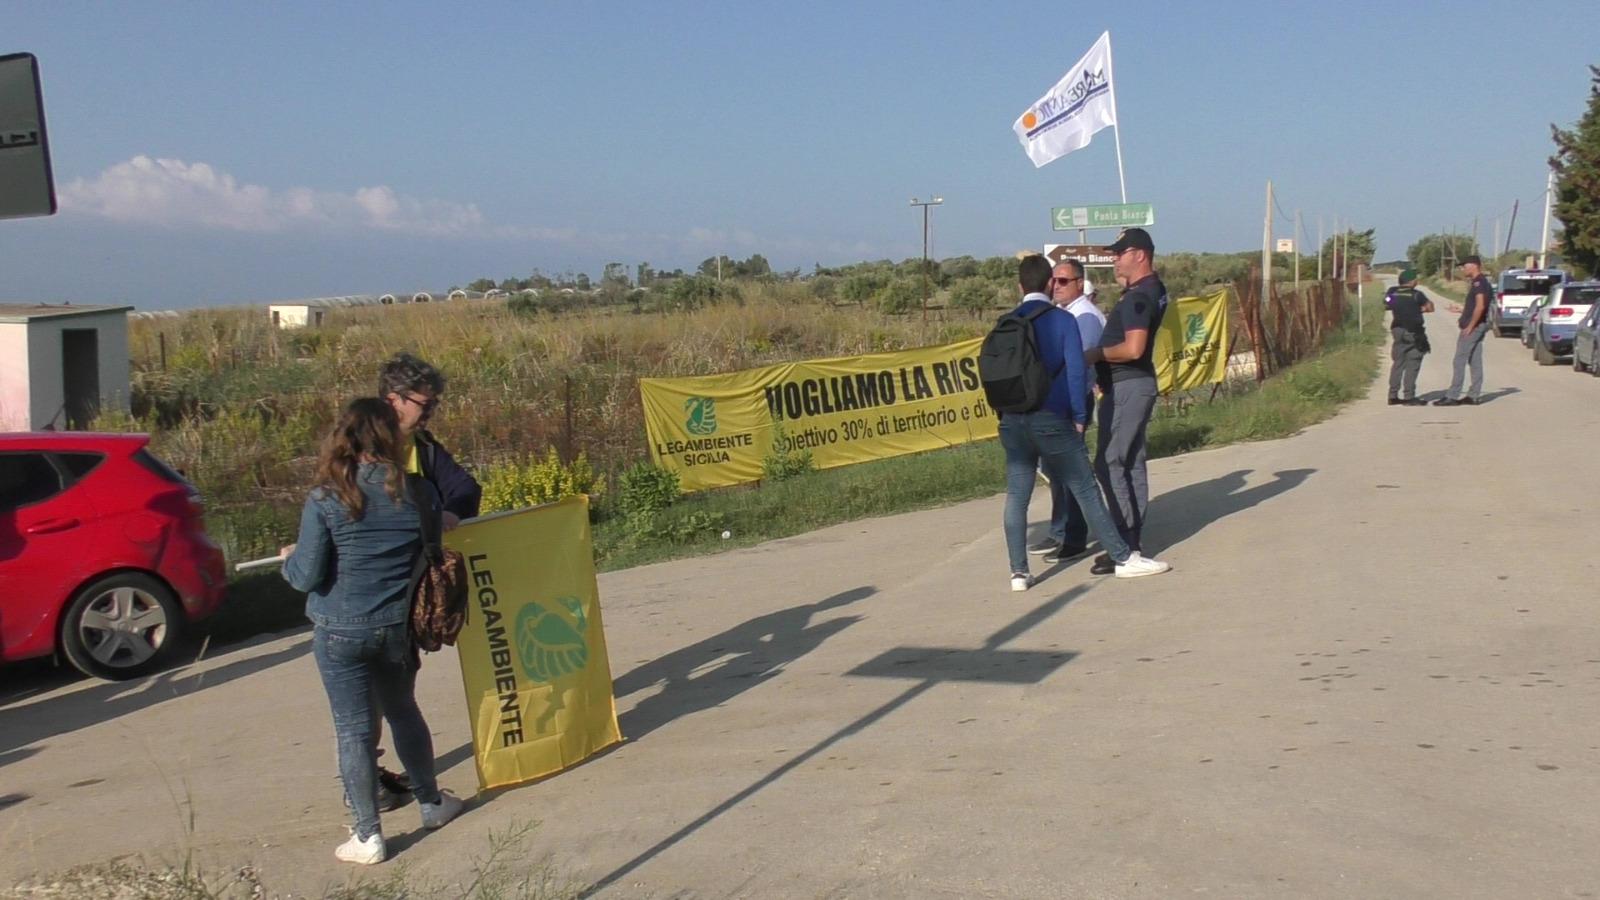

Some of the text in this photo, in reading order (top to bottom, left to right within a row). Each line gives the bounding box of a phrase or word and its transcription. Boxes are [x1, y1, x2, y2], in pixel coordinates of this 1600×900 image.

[1089, 253, 1115, 263] Bianc
[765, 370, 896, 421] VOGLIAMO
[899, 365, 933, 402] LA
[841, 418, 873, 441] 30%
[877, 415, 890, 436] di
[893, 405, 957, 433] territorio
[961, 406, 970, 421] e
[974, 398, 987, 419] di
[657, 433, 753, 456] LEGAMBIENTE
[684, 451, 730, 467] SICILIA
[469, 553, 523, 748] LEGAMBIENTE
